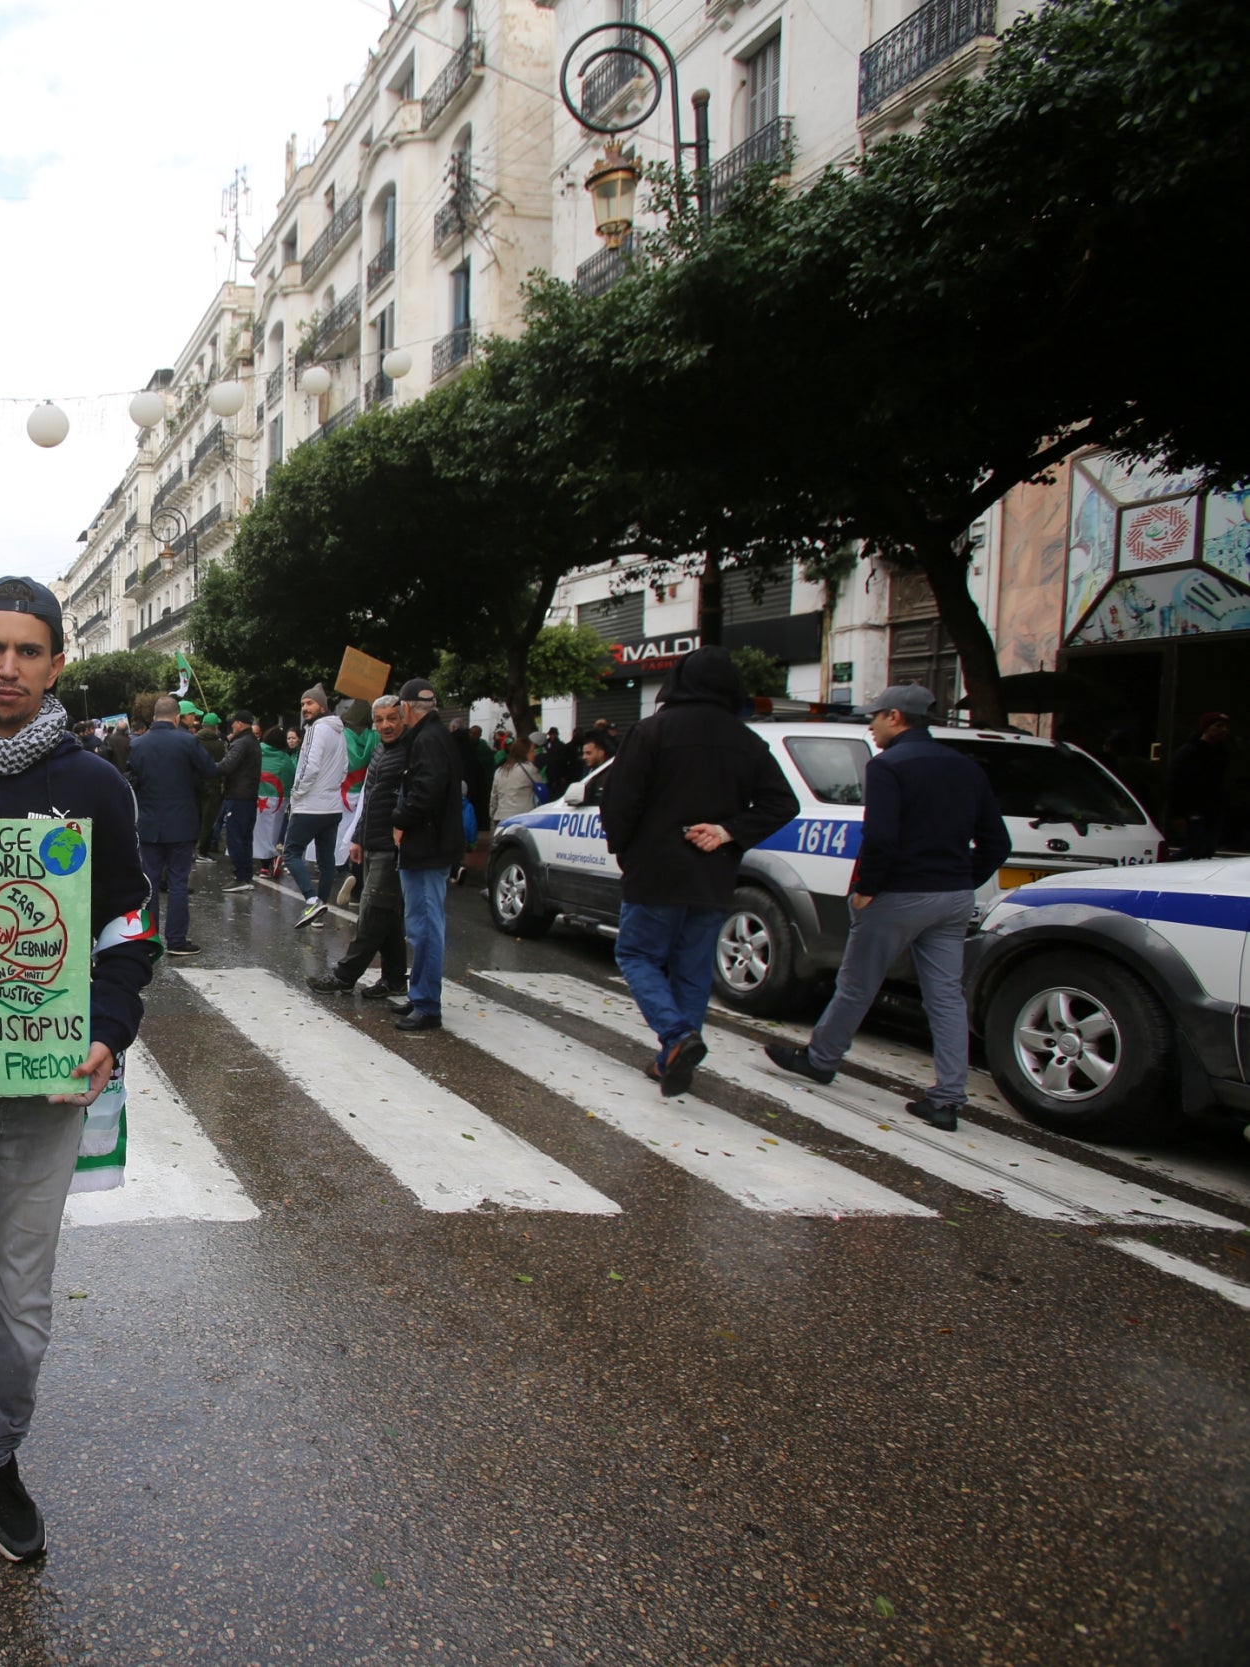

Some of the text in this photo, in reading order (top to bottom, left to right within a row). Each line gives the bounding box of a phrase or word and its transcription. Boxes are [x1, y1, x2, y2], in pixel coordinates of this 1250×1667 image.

[609, 636, 701, 664] RIVALDI
[640, 661, 675, 671] FASH
[797, 821, 847, 854] 1614
[7, 887, 45, 927] IRAQ
[15, 939, 62, 957] LEBANON
[5, 1015, 52, 1042] STOP
[54, 1016, 84, 1041] US
